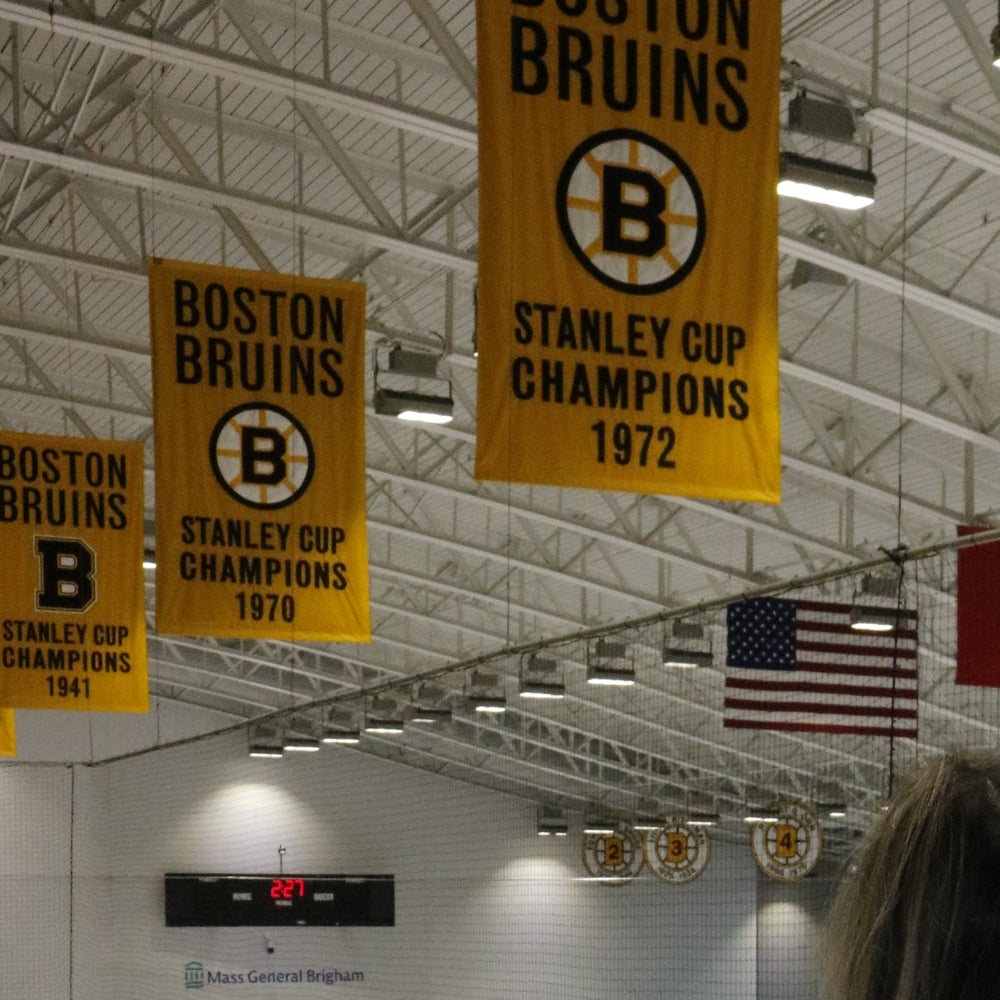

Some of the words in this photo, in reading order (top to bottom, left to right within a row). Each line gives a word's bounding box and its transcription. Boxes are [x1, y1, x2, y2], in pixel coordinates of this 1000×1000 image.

[510, 17, 750, 133] BRUINS
[601, 163, 668, 258] B
[174, 279, 345, 343] BOSTON
[514, 300, 671, 360] STANLEY
[681, 320, 746, 366] CUP
[175, 334, 345, 398] BRUINS
[510, 356, 750, 422] CHAMPIONS
[0, 444, 127, 489] BOSTON
[241, 425, 288, 487] B
[591, 421, 677, 469] 1972
[0, 484, 127, 530] BRUINS
[180, 516, 291, 552] STANLEY
[299, 526, 346, 555] CUP
[35, 536, 96, 613] B
[179, 550, 348, 590] CHAMPIONS
[235, 592, 296, 623] 1970
[2, 619, 87, 645] STANLEY
[93, 624, 129, 647] CUP
[2, 646, 131, 673] CHAMPIONS
[46, 675, 90, 698] 1941
[608, 844, 619, 860] 2
[671, 840, 682, 856] 3
[780, 832, 791, 851] 4
[207, 970, 244, 984] Mass
[247, 970, 303, 983] General
[306, 968, 365, 985] Brigham
